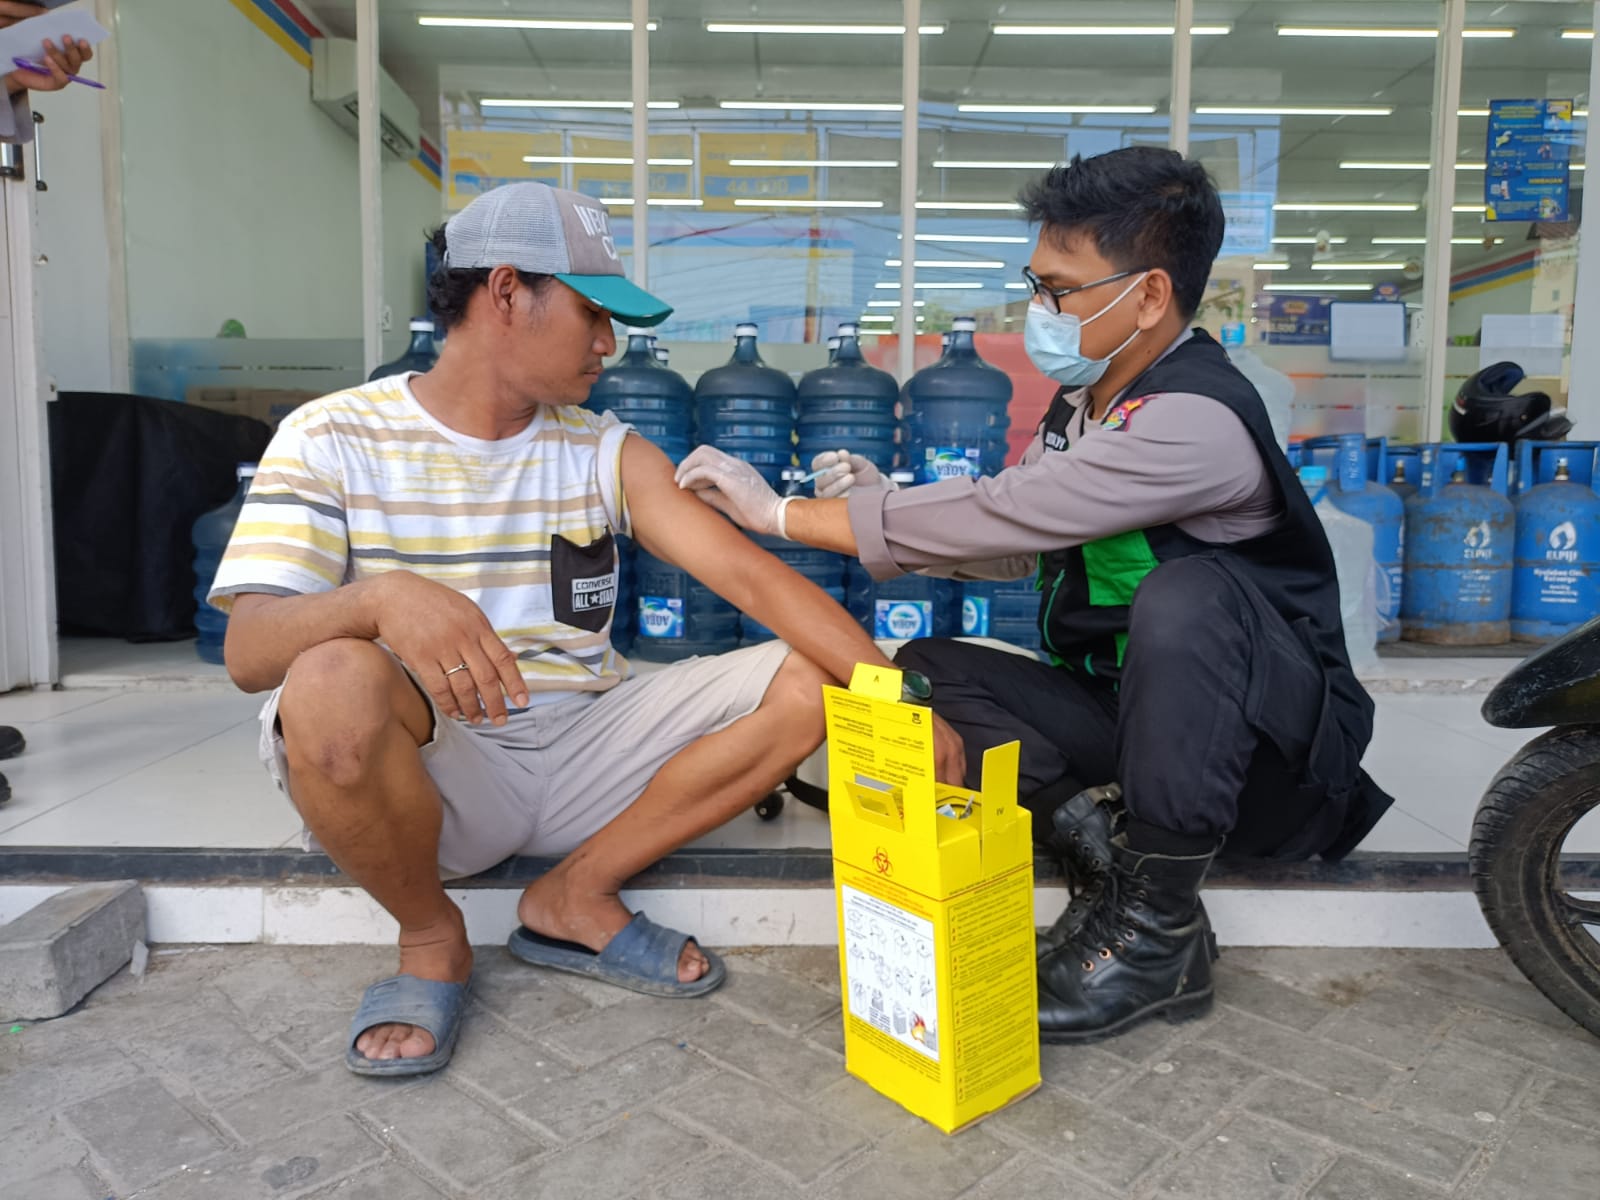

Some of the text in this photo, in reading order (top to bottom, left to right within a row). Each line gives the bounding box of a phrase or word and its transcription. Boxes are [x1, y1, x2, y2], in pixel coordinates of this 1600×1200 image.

[936, 463, 968, 476] AQUA
[575, 576, 613, 591] CONVERSE
[575, 593, 590, 608] ALL
[645, 615, 671, 627] AQUA
